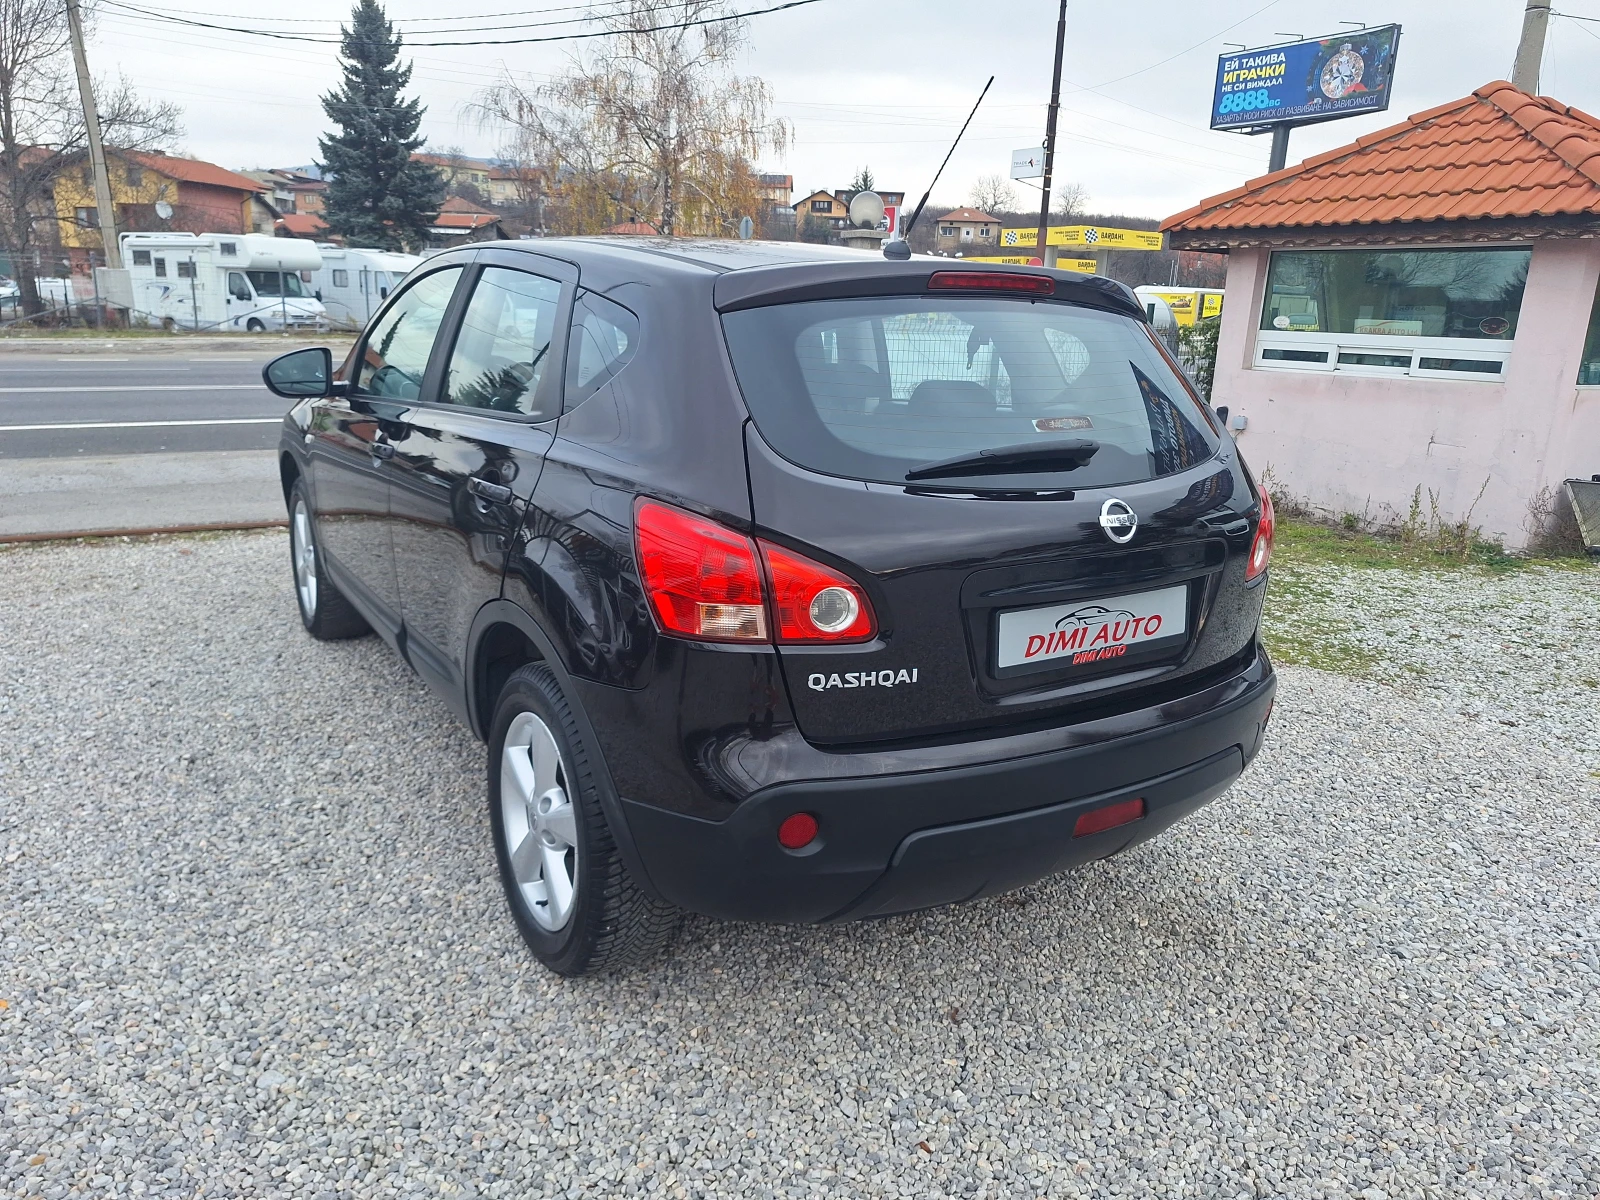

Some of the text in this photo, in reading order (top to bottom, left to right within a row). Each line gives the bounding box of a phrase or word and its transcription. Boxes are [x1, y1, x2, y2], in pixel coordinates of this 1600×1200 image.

[1224, 52, 1286, 71] ЕЙ ТАКИВА
[1223, 64, 1286, 83] ИГРАЧКИ
[1221, 77, 1283, 92] НЕ СИ ВИЖДАЛ
[1215, 113, 1244, 124] ХАЗАРТЪТ
[1244, 112, 1260, 121] НОСИ
[1260, 110, 1276, 119] РИСК
[1286, 105, 1322, 115] РАЗВИВАНЕ
[1323, 103, 1332, 111] НА
[1332, 95, 1377, 109] ЗАВИСИМОСТ
[1101, 232, 1125, 242] BARDAHL
[1024, 614, 1163, 658] DIMI AUTO
[1072, 644, 1127, 665] DIMI AUTO
[807, 668, 919, 692] QASHQAI
